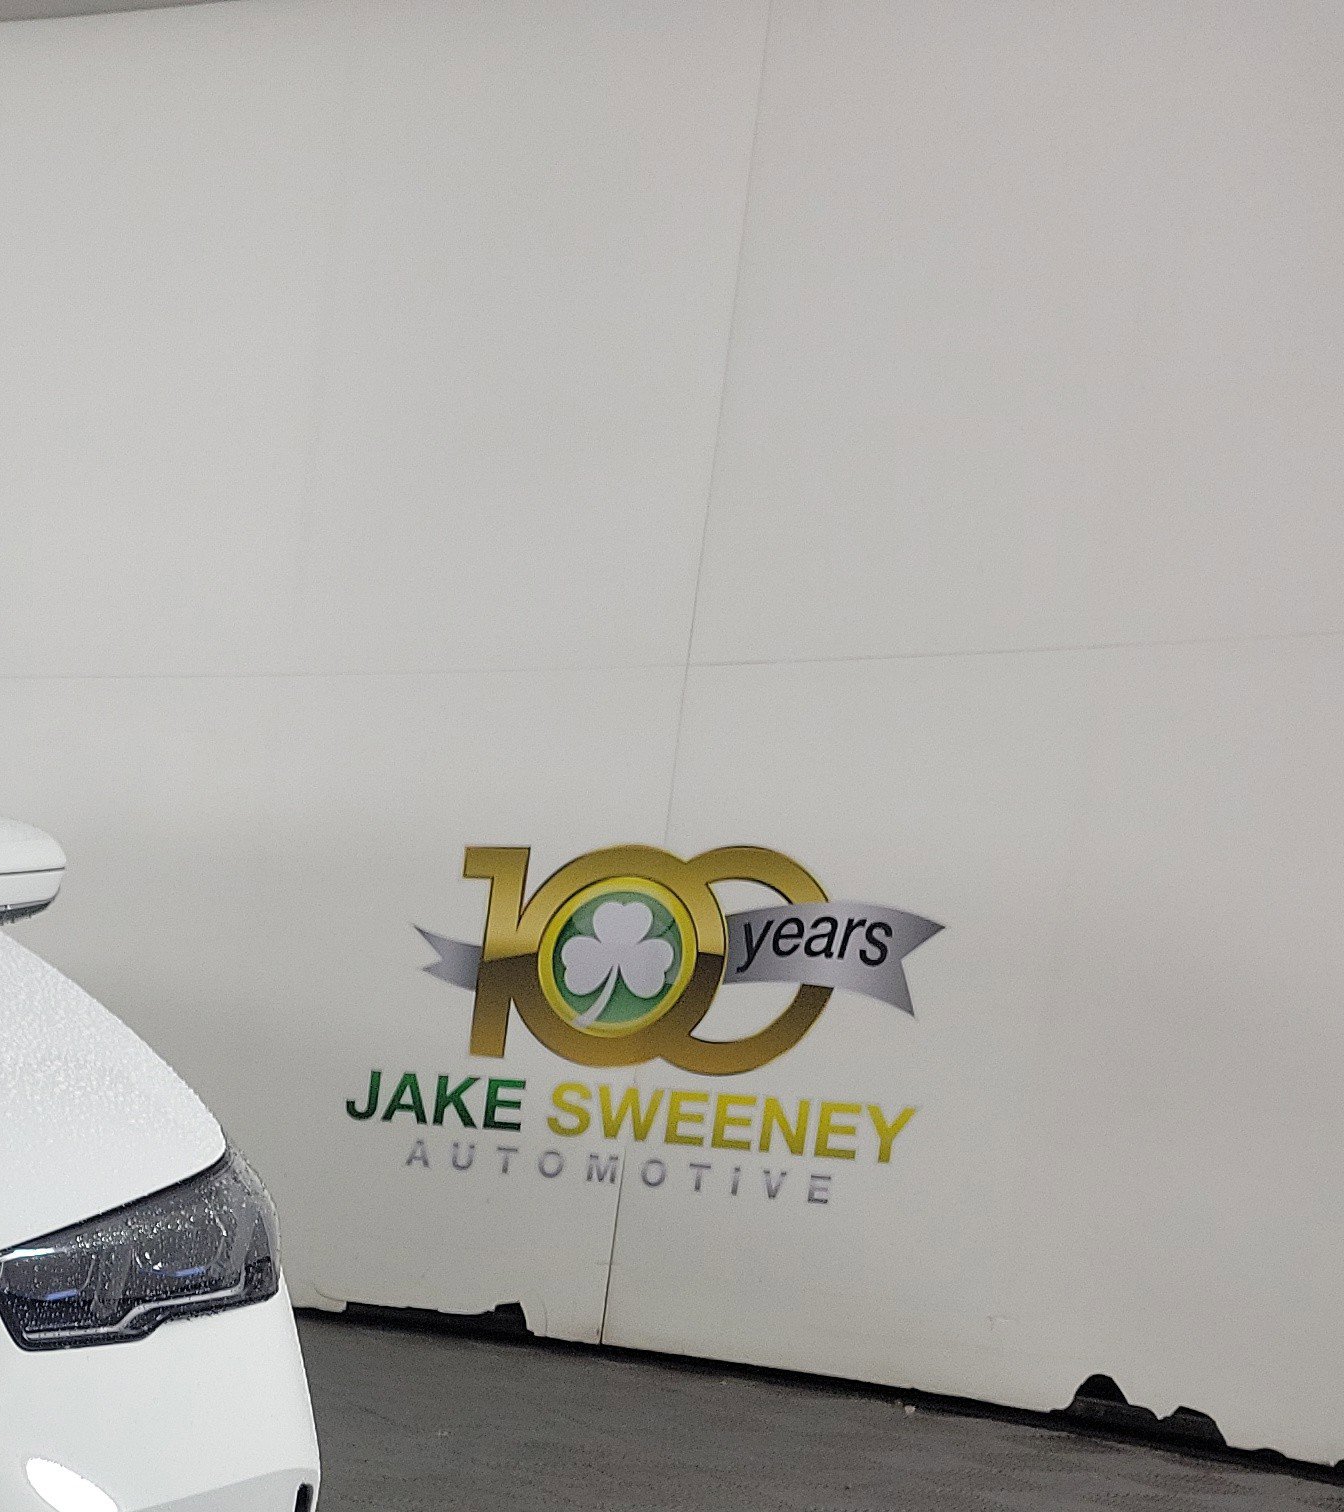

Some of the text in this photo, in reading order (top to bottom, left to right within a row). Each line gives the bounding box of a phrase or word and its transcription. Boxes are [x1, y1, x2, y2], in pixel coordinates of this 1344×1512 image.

[463, 845, 834, 1076] 100
[736, 914, 894, 974] years
[346, 1070, 916, 1164] JAKE SWEENEY
[406, 1139, 833, 1205] AUTOMOTIVE
